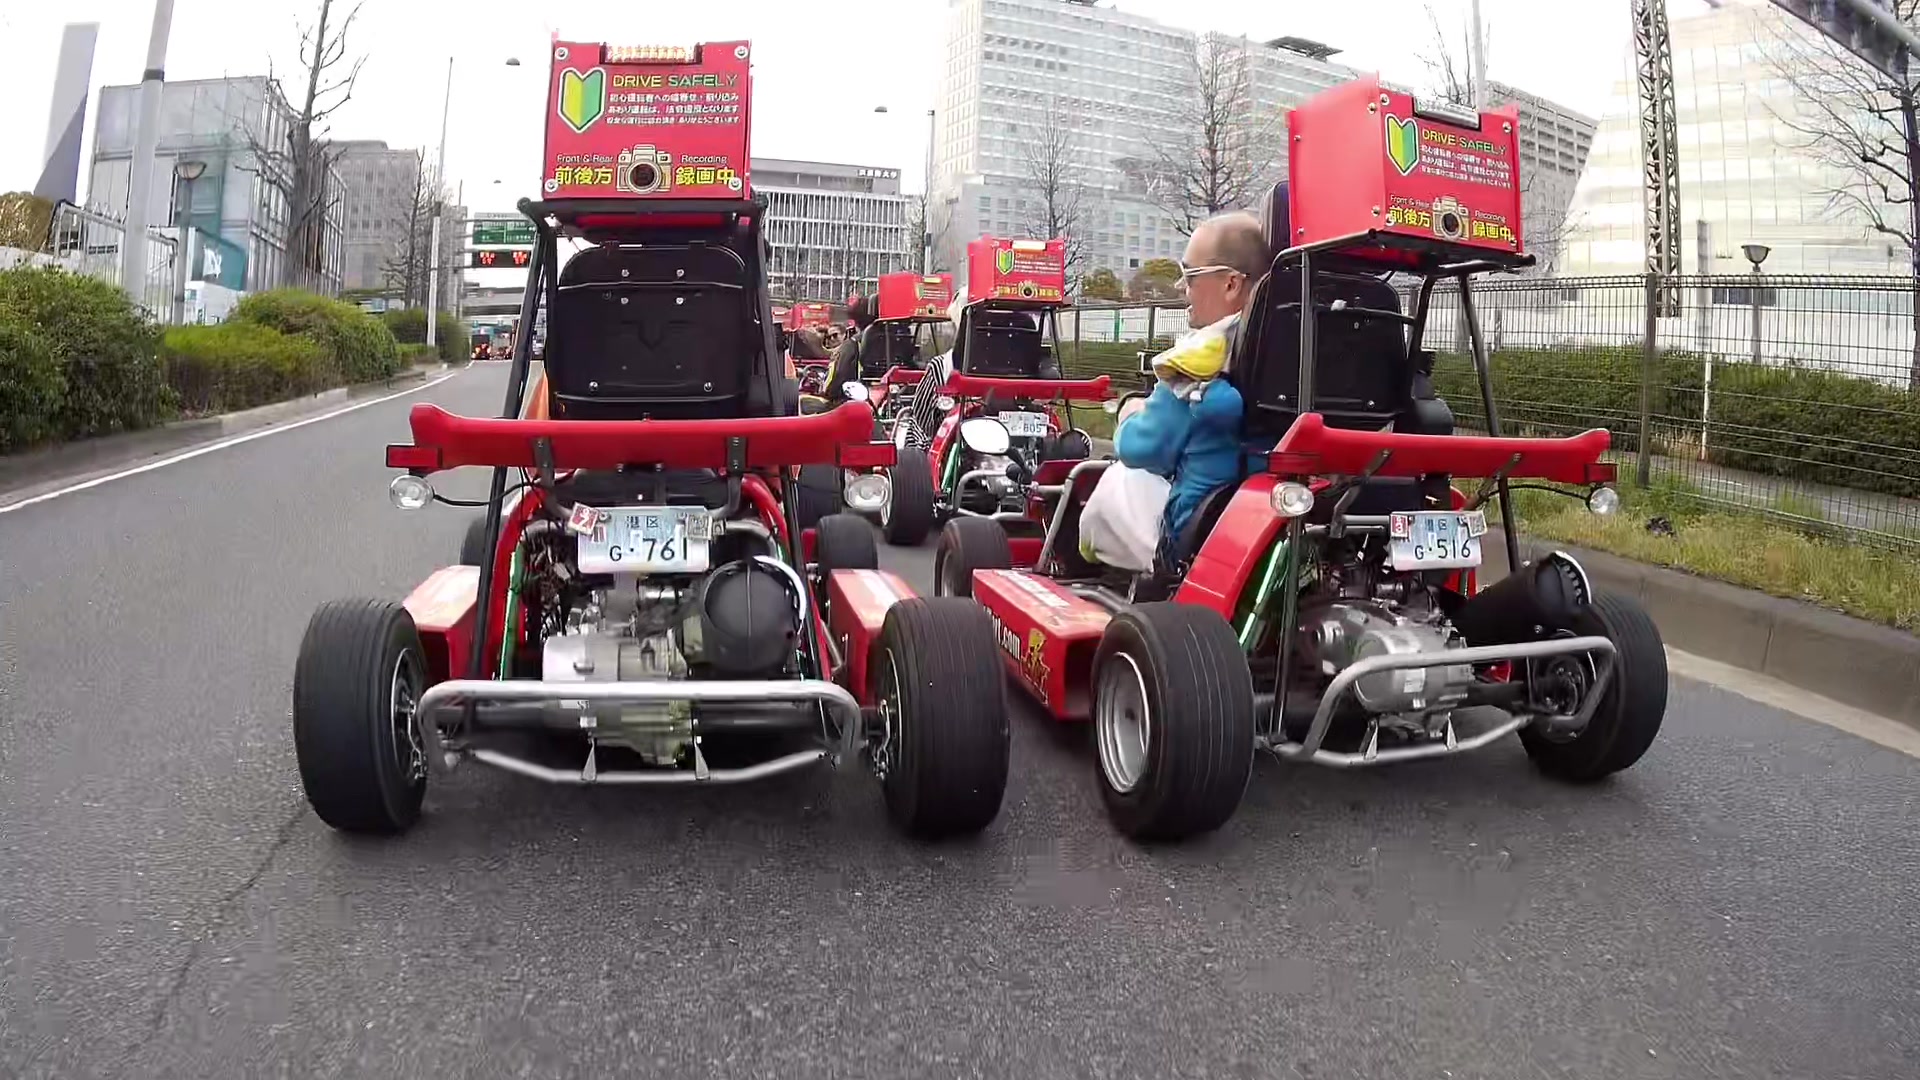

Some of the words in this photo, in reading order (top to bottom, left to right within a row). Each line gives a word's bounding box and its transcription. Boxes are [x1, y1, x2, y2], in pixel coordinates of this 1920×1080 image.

[612, 75, 662, 87] DRIVE
[668, 74, 738, 87] SAFELY
[1422, 128, 1456, 146] DRIVE
[1459, 137, 1506, 155] SAFELY
[556, 154, 580, 163] Front
[593, 155, 614, 163] Rear
[681, 155, 727, 164] Recording
[555, 166, 613, 185] 前後方
[675, 166, 736, 185] 録画中
[1389, 206, 1431, 228] 前後方
[1472, 220, 1511, 241] 録画中
